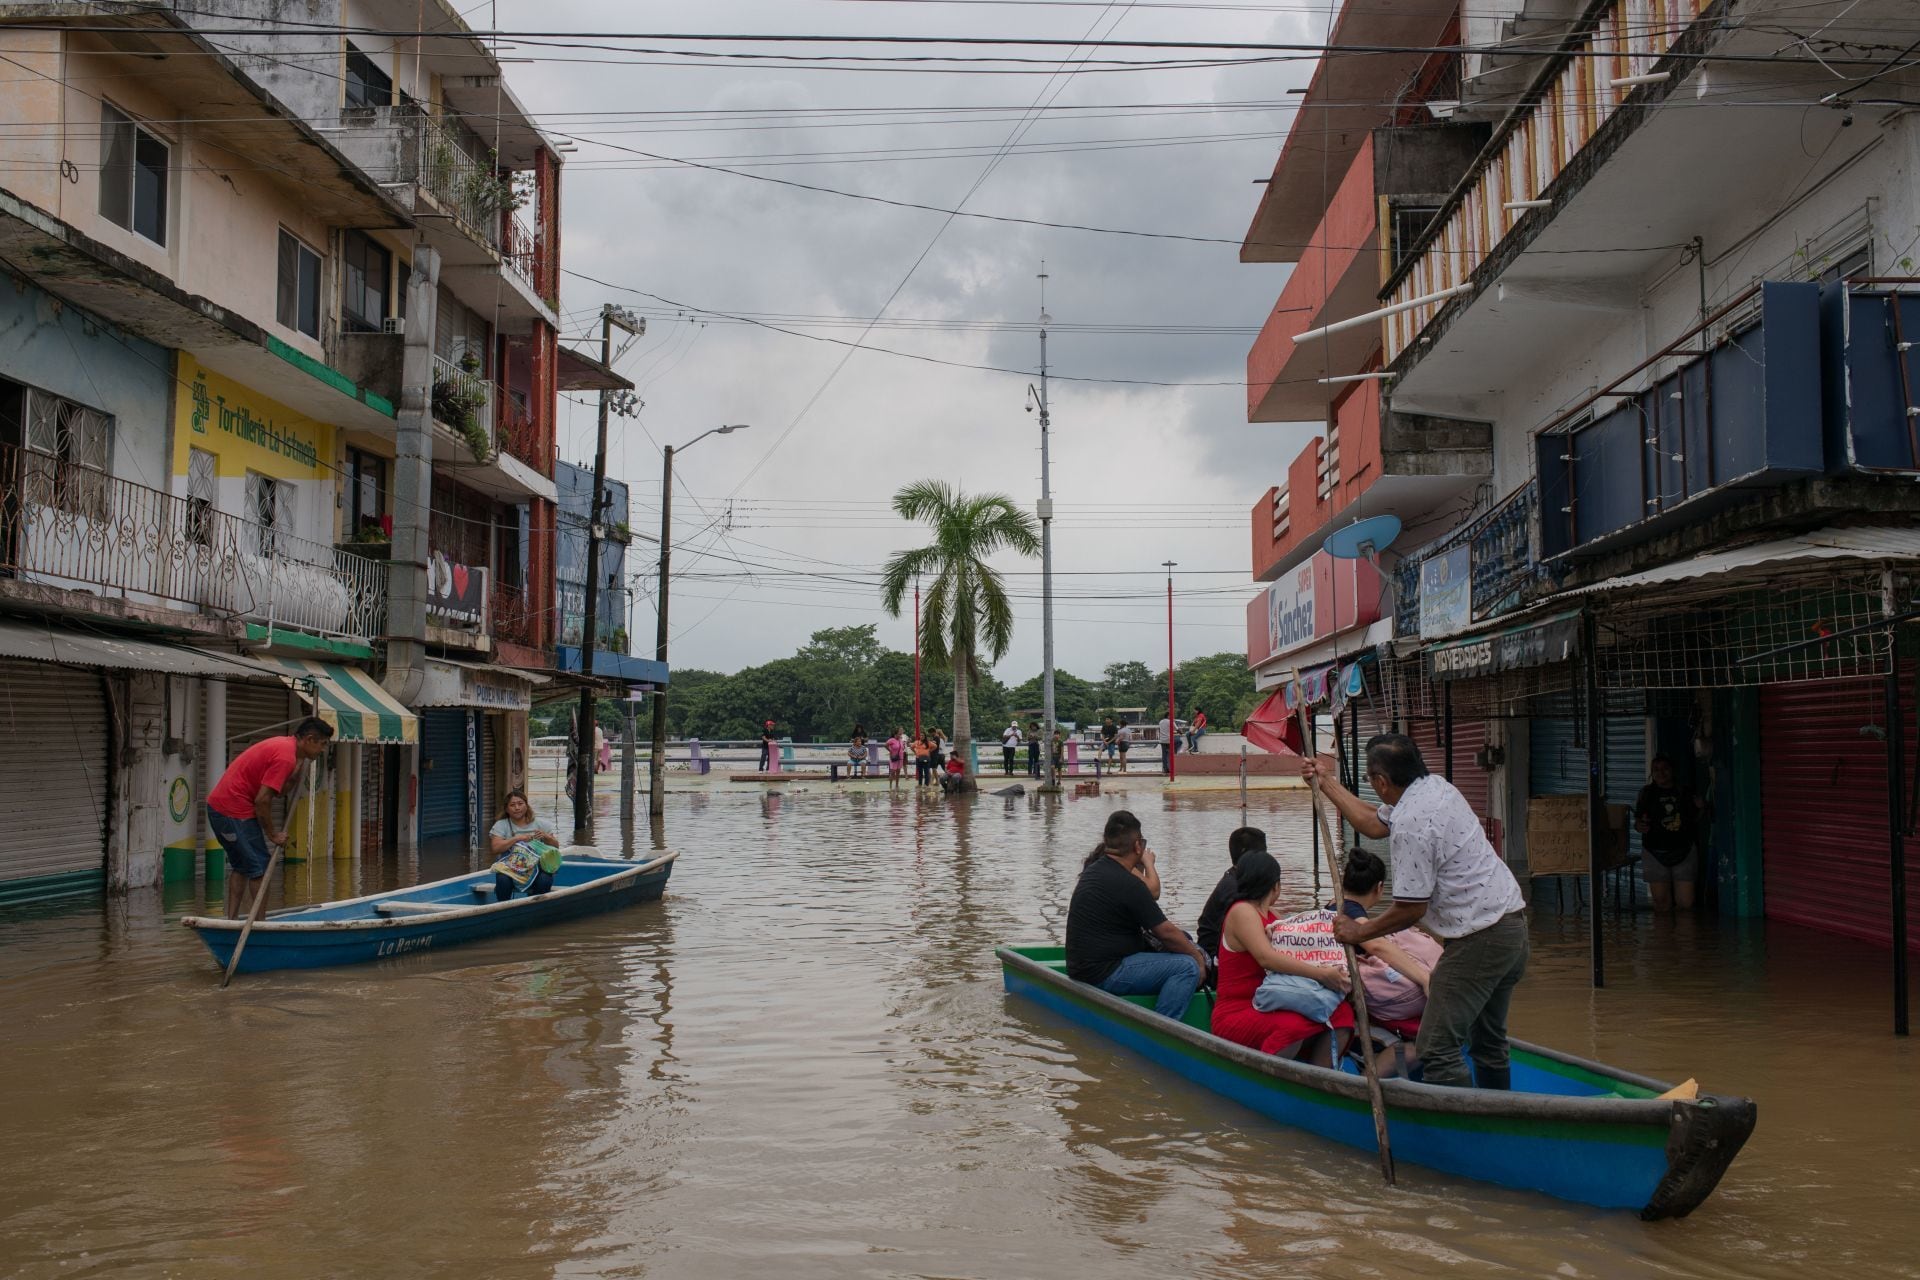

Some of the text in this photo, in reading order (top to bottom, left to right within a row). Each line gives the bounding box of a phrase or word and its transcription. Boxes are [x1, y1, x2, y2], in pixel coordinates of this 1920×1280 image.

[268, 419, 280, 453] La
[1434, 641, 1491, 673] NOVEDADES
[466, 715, 476, 775] PODER
[377, 941, 395, 956] La
[1272, 934, 1315, 947] HUATULCO
[1295, 950, 1343, 961] HUATULCO
